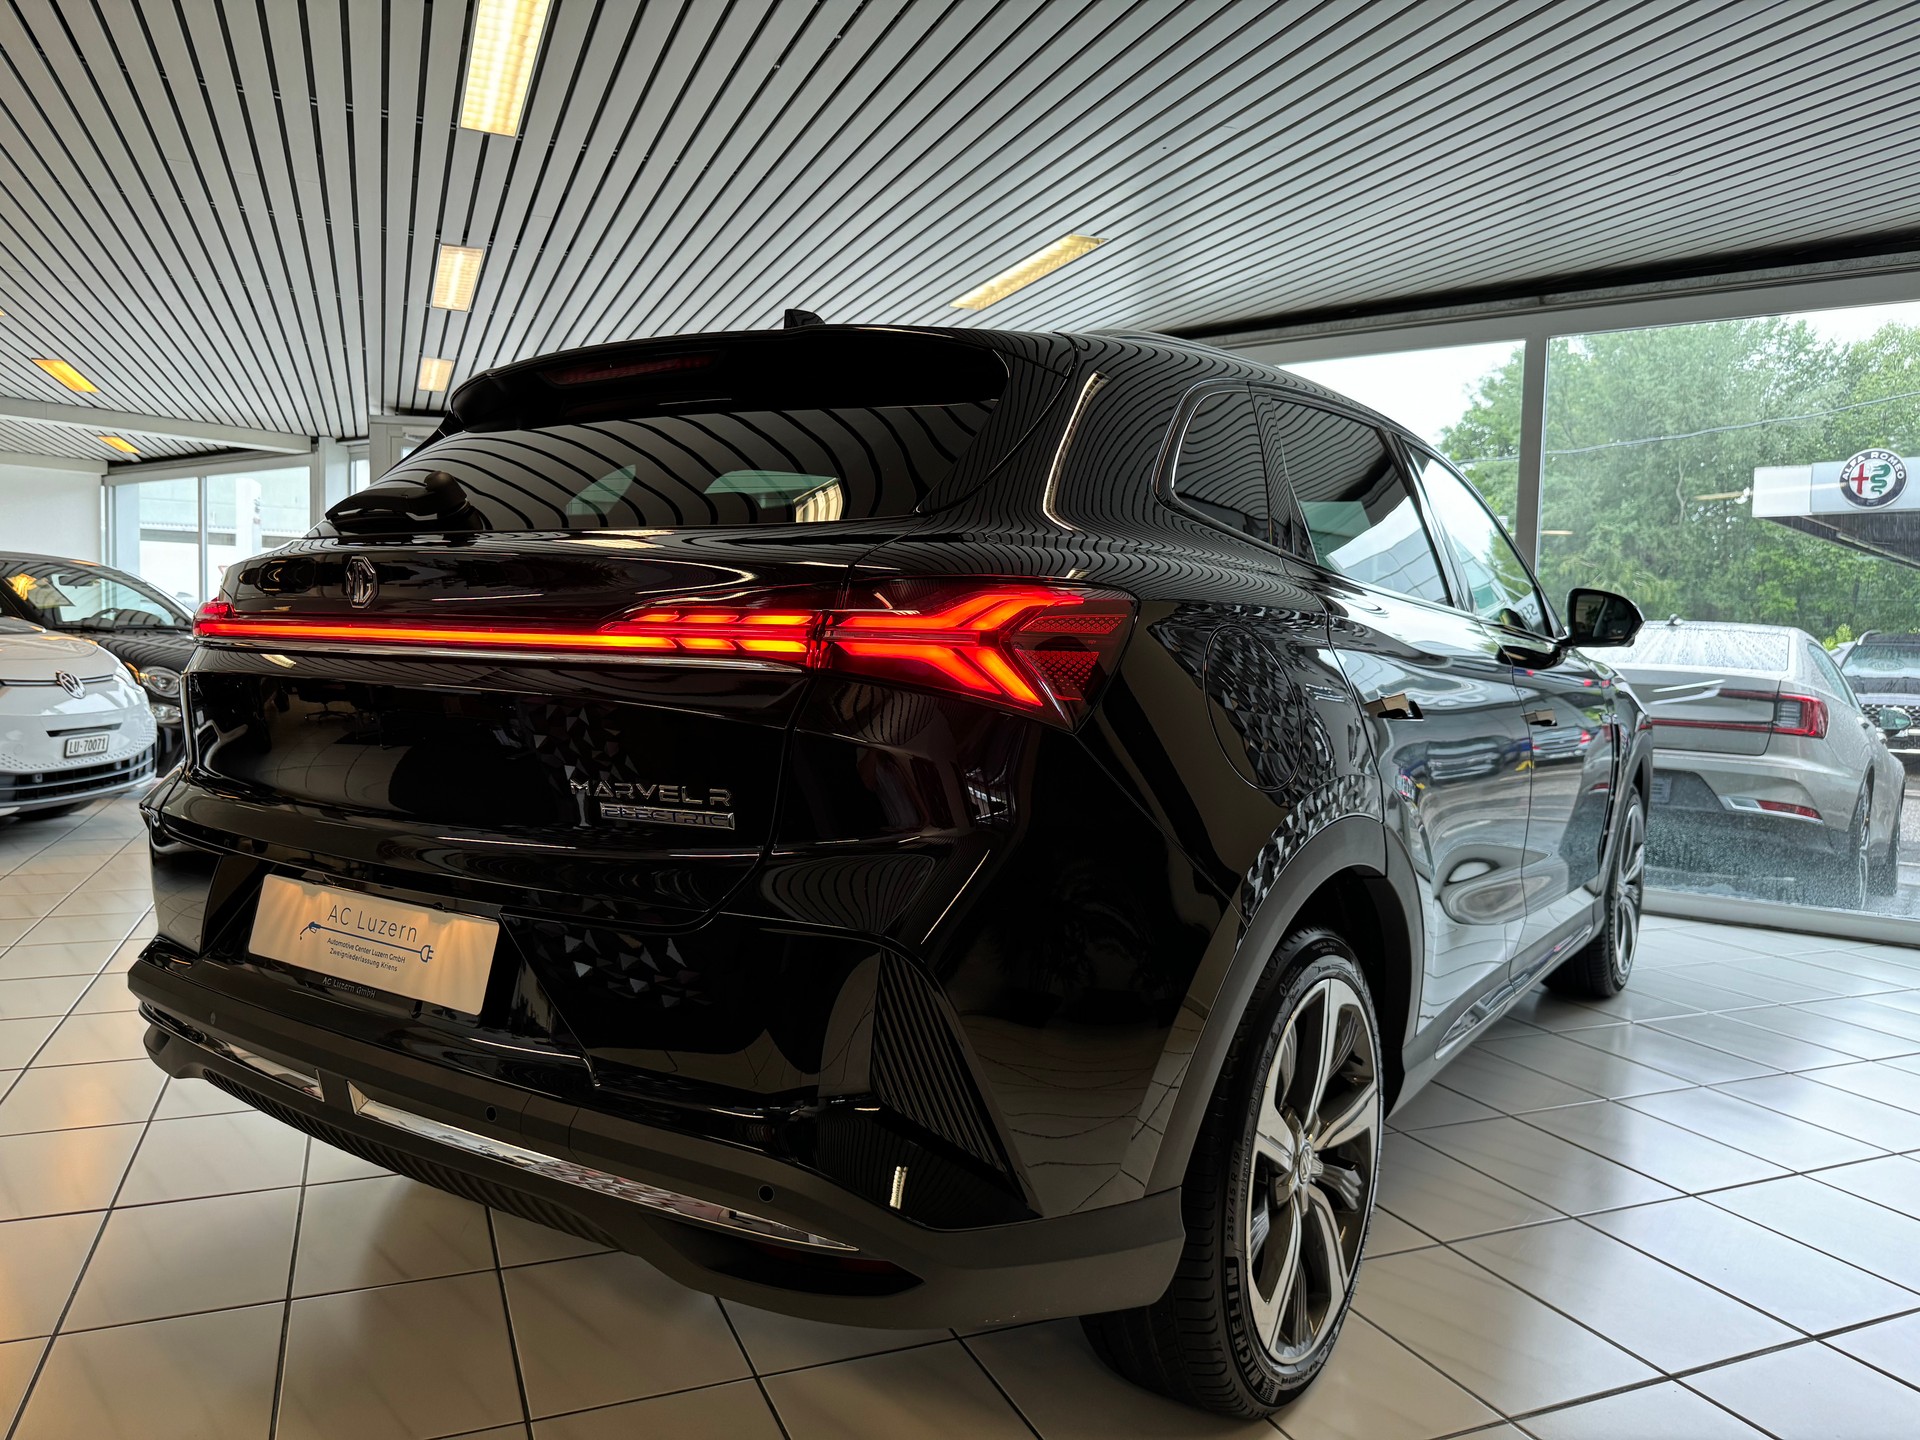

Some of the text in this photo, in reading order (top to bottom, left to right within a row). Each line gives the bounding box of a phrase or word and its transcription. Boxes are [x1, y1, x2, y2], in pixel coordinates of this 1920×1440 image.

[1842, 451, 1905, 480] ALFA ROMEO
[570, 779, 732, 806] MARVEL R
[602, 804, 732, 828] ELECTRIC
[327, 904, 417, 943] AC Luzern
[327, 938, 406, 963] Automotive Center Luzern GmbH
[329, 947, 398, 972] Zweigniederlassung Kriens
[322, 977, 376, 998] AC Luzern GmbH
[1226, 1151, 1240, 1241] 235/45 R 19
[1226, 1266, 1264, 1387] MICHELIN
